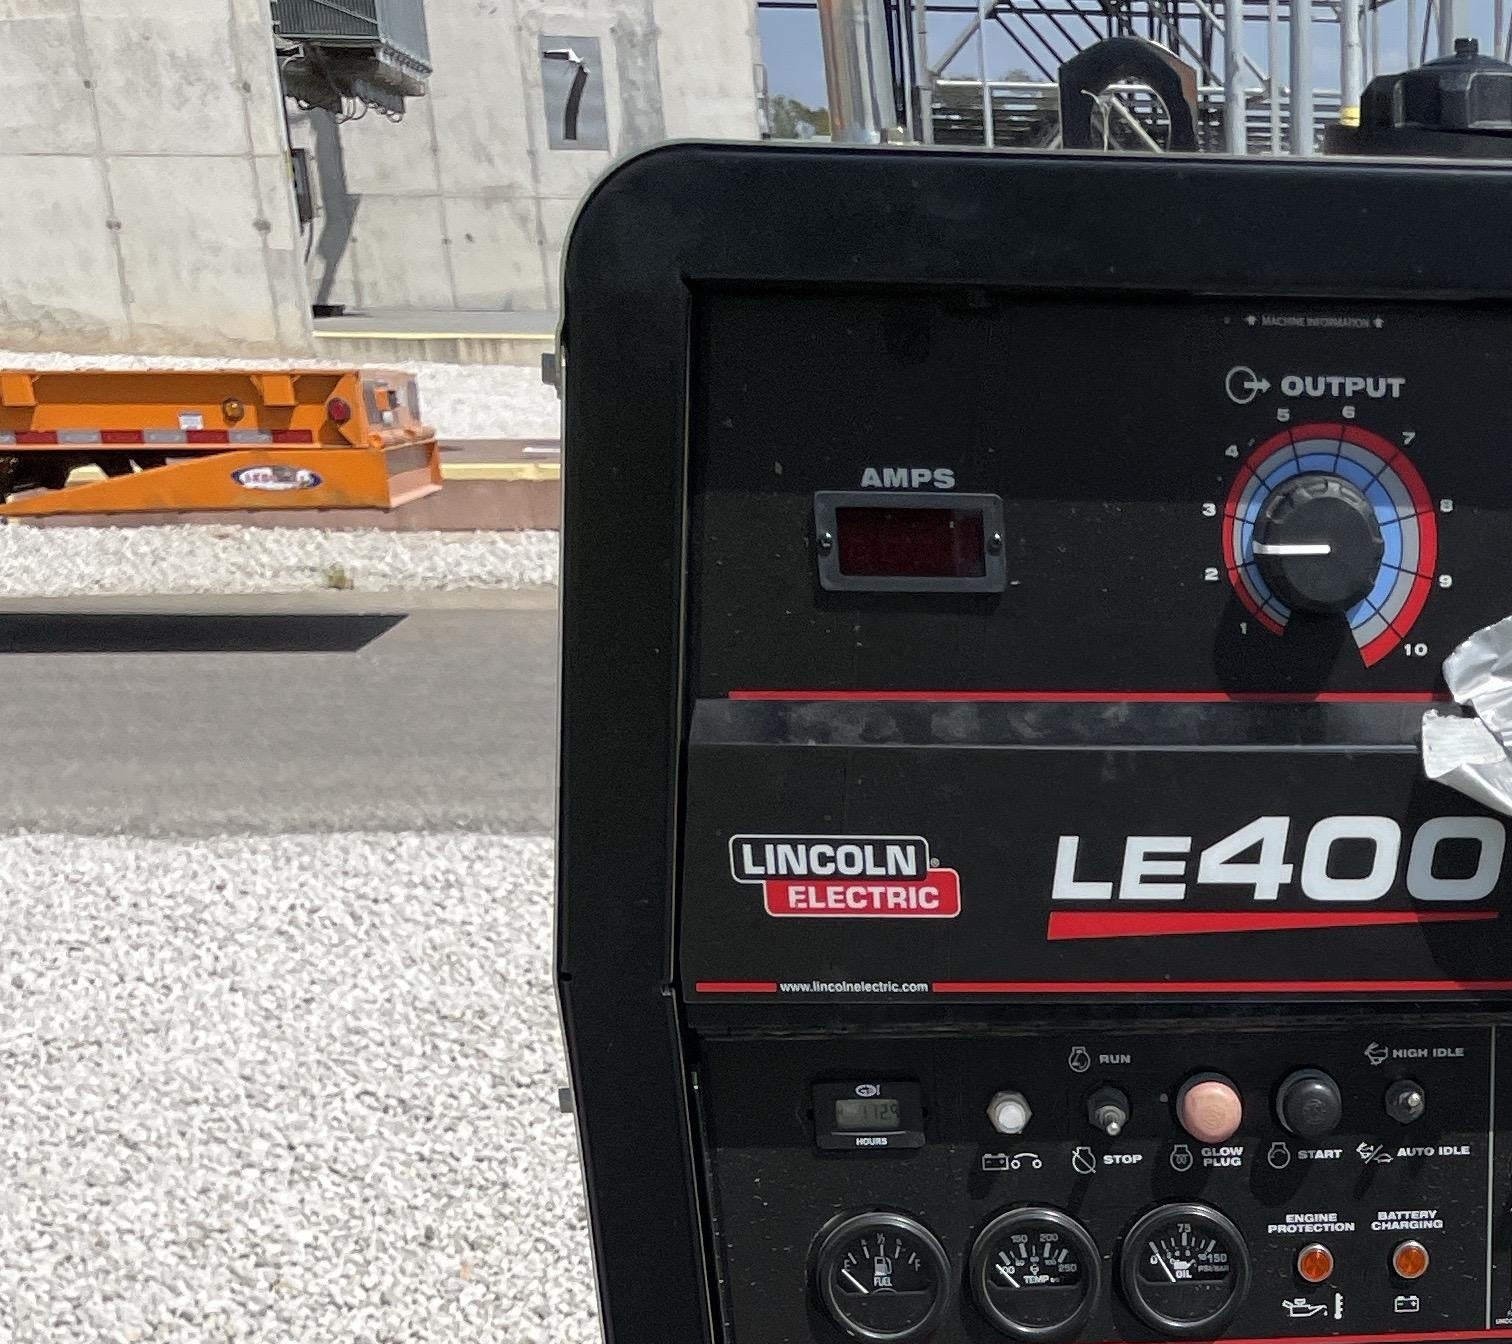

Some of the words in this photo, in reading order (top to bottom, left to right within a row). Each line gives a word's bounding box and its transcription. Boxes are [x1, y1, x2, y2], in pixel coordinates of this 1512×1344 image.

[1280, 375, 1406, 398] OUTPUT
[1277, 408, 1290, 421] 5
[1341, 406, 1355, 419] 6
[1402, 431, 1416, 445] 7
[1225, 445, 1239, 458] 4
[861, 467, 956, 489] AMPS
[1202, 503, 1216, 517] 3
[1440, 499, 1453, 512] 8
[1204, 567, 1219, 581] 2
[1440, 575, 1452, 588] 9
[1240, 622, 1247, 635] 1
[1403, 643, 1428, 656] 10
[741, 844, 918, 876] LINCOLN
[1051, 816, 1507, 901] LE400
[787, 886, 940, 910] ELECTRIC
[779, 980, 929, 994] www.lincolnelectric.com
[1393, 1048, 1428, 1058] HIGH
[1432, 1047, 1464, 1057] IDLE
[1099, 1054, 1131, 1064] RUN
[856, 1137, 888, 1146] HOURS
[1201, 1147, 1244, 1157] GLOW
[1298, 1149, 1342, 1160] START
[1397, 1147, 1434, 1157] AUTO
[1438, 1146, 1470, 1156] IDLE
[1103, 1154, 1143, 1165] STOP
[1203, 1157, 1242, 1167] PLUG
[1285, 1213, 1338, 1223] ENGINE
[1378, 1210, 1437, 1221] BATTERY
[1177, 1223, 1191, 1233] 75
[1268, 1222, 1355, 1233] PROTECTION
[1371, 1219, 1444, 1231] CHARGING
[1040, 1233, 1058, 1242] 200
[1023, 1275, 1049, 1283] TEMP
[1176, 1269, 1192, 1278] OIL
[874, 1276, 893, 1287] FUEL
